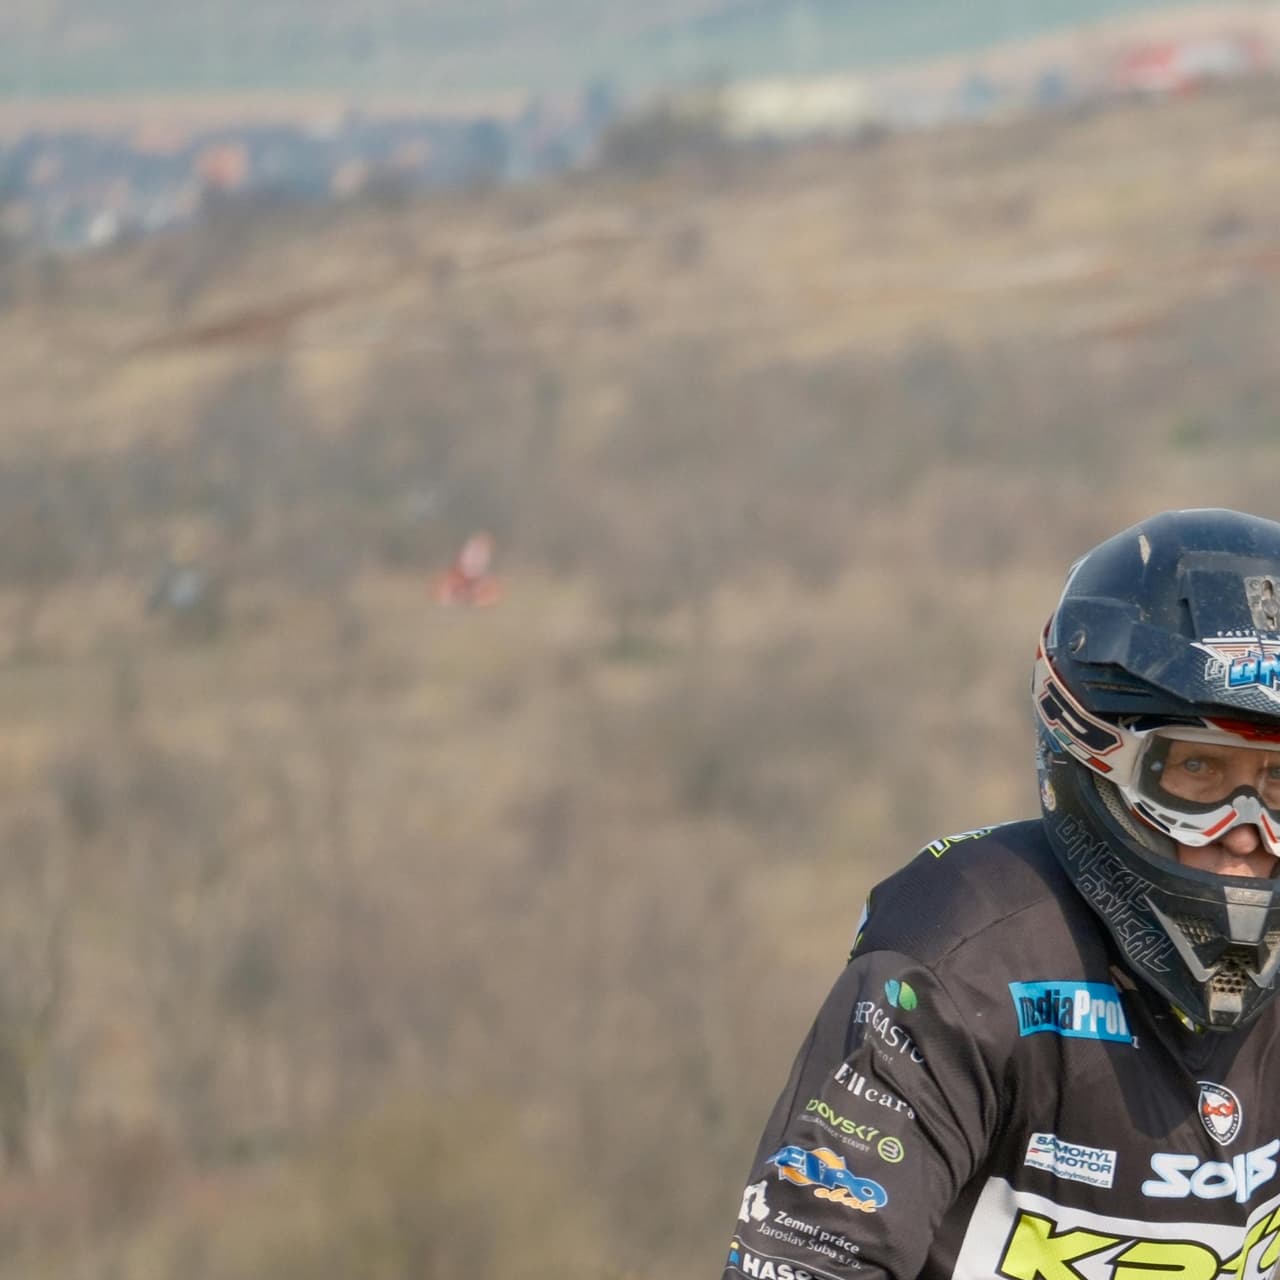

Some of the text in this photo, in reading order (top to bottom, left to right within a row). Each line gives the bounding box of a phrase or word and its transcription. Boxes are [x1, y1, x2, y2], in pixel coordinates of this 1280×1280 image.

[1054, 1152, 1112, 1175] MOTOR
[757, 1221, 806, 1248] Jaroslav
[774, 1209, 861, 1255] Zemní práce
